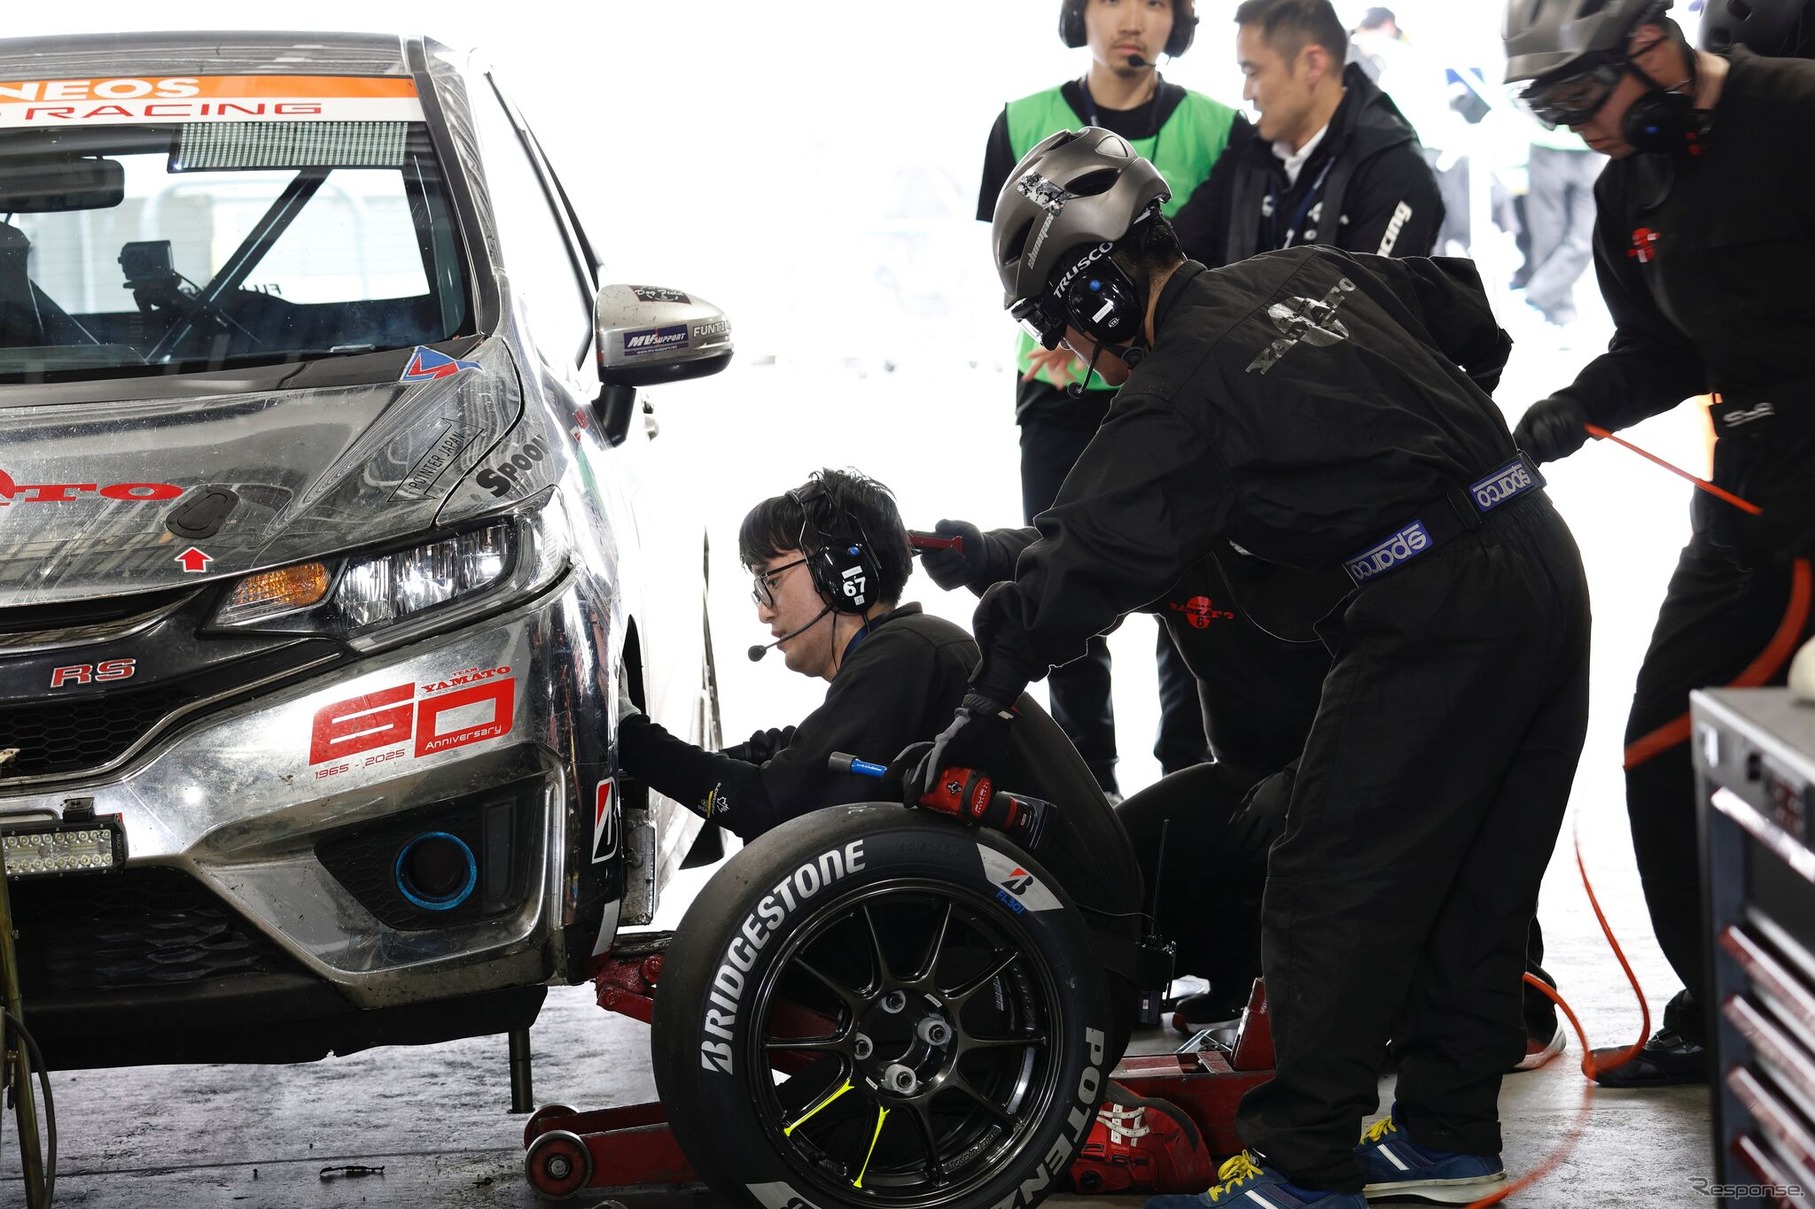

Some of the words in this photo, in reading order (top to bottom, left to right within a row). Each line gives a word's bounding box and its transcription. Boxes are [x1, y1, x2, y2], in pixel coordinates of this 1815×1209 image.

[25, 103, 322, 120] RACING
[1053, 242, 1114, 299] TRUSCO
[408, 454, 445, 491] POINTER
[442, 431, 466, 457] JAPAN
[1473, 463, 1532, 508] sparco
[1347, 523, 1428, 581] sparco
[843, 577, 866, 597] 67
[50, 658, 136, 688] RS
[421, 666, 511, 693] YAMATO
[451, 666, 478, 677] TEAM
[309, 677, 515, 766] 60
[425, 725, 502, 750] Anniversary
[315, 763, 349, 780] 1965
[364, 748, 406, 767] 2025
[701, 839, 866, 1076] BRIDGESTONE
